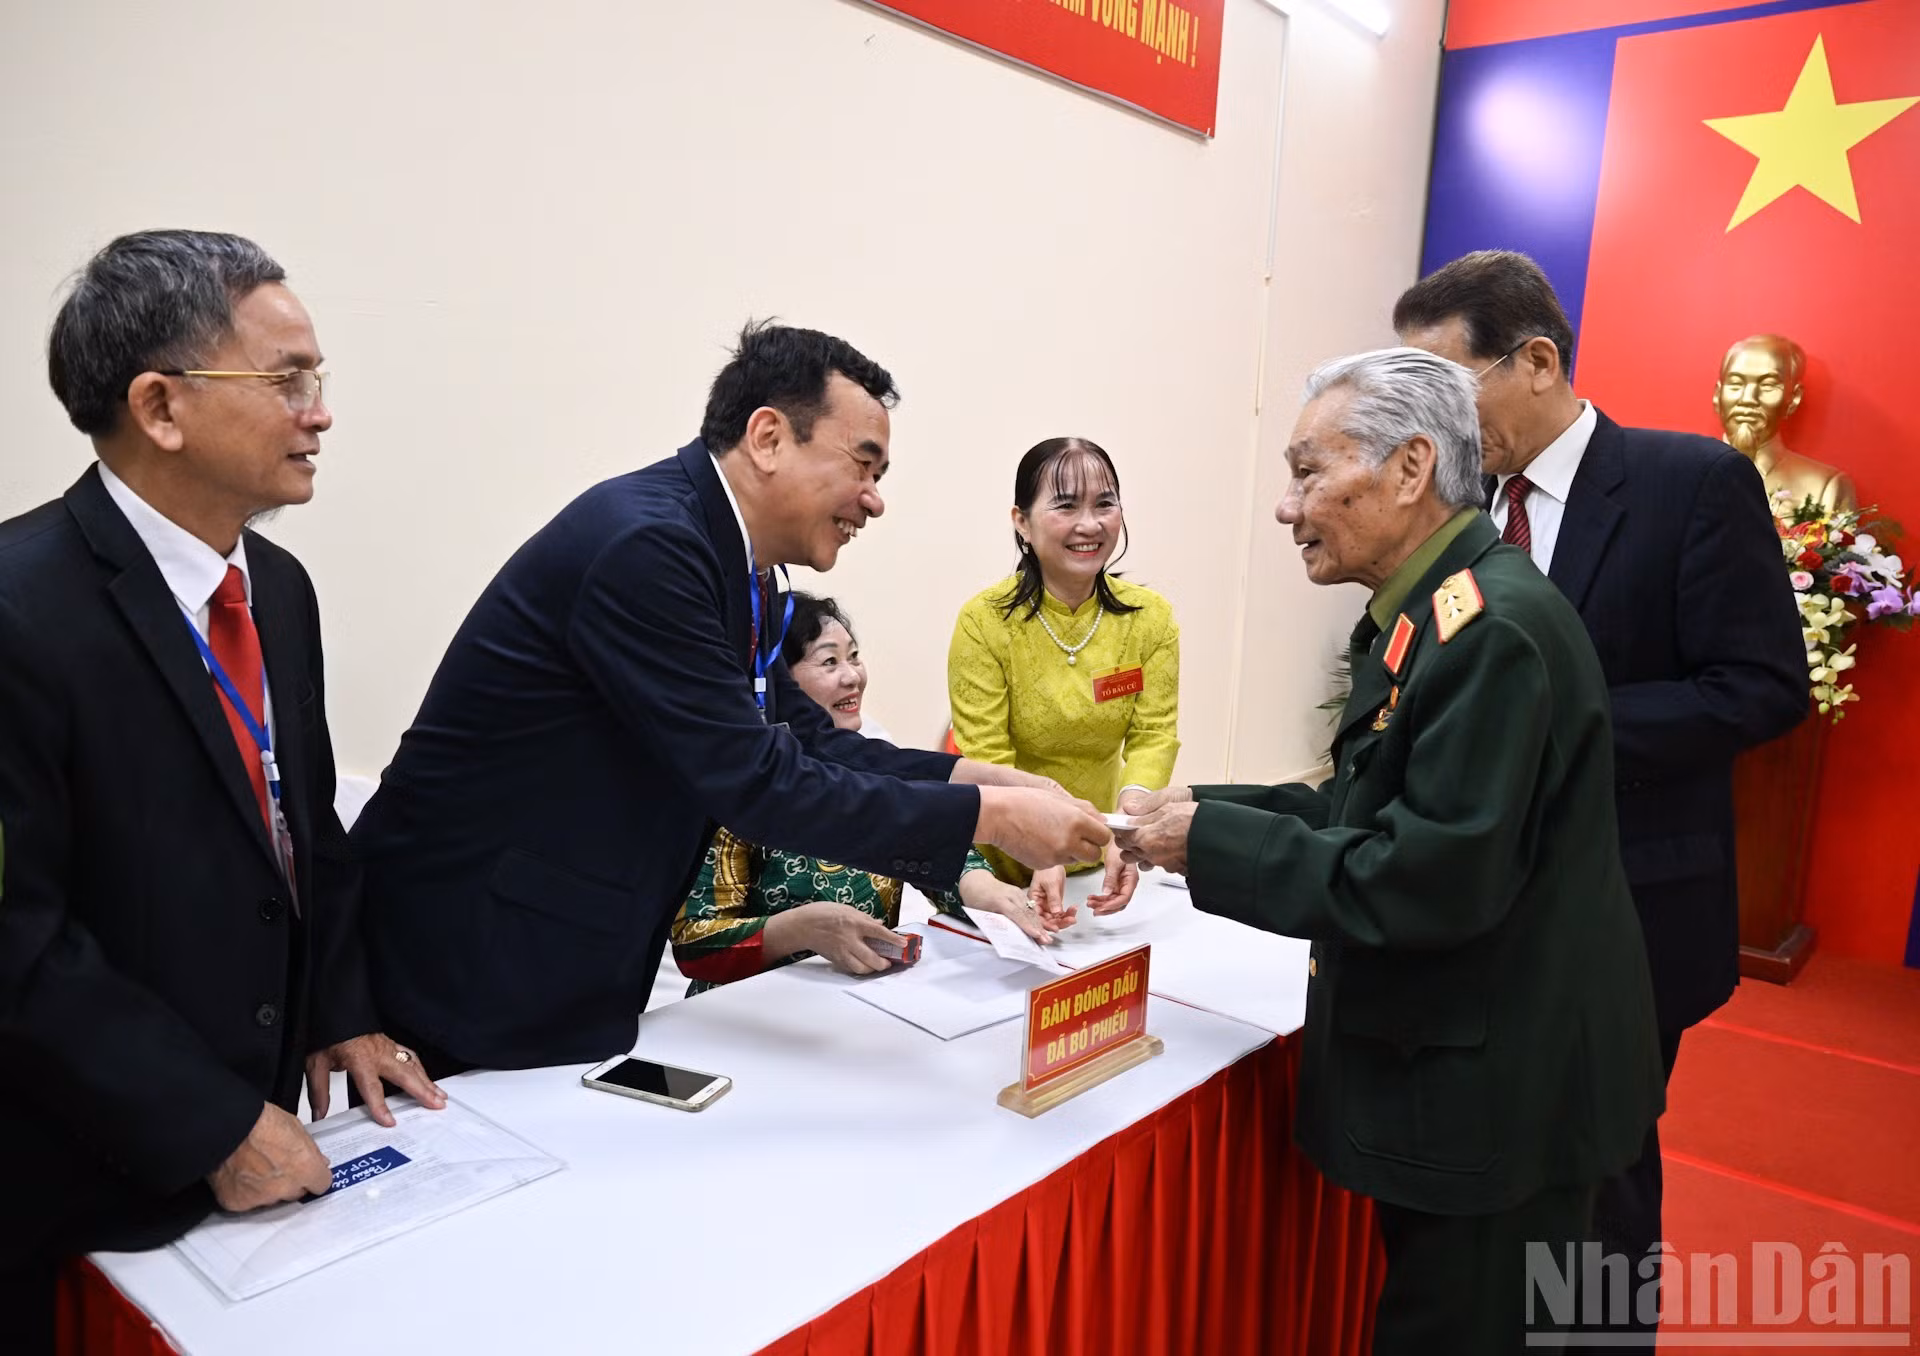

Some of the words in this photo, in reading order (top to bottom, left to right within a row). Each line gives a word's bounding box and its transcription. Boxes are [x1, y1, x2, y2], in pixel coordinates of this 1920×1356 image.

[1140, 0, 1190, 64] MẠNH
[1041, 998, 1071, 1030] BÀN
[1073, 981, 1110, 1017] ĐÓNG
[1112, 965, 1139, 999] DẤU
[1046, 1035, 1066, 1065] ĐÃ
[1069, 1020, 1088, 1054] BỎ
[1091, 1005, 1129, 1045] PHIẾU
